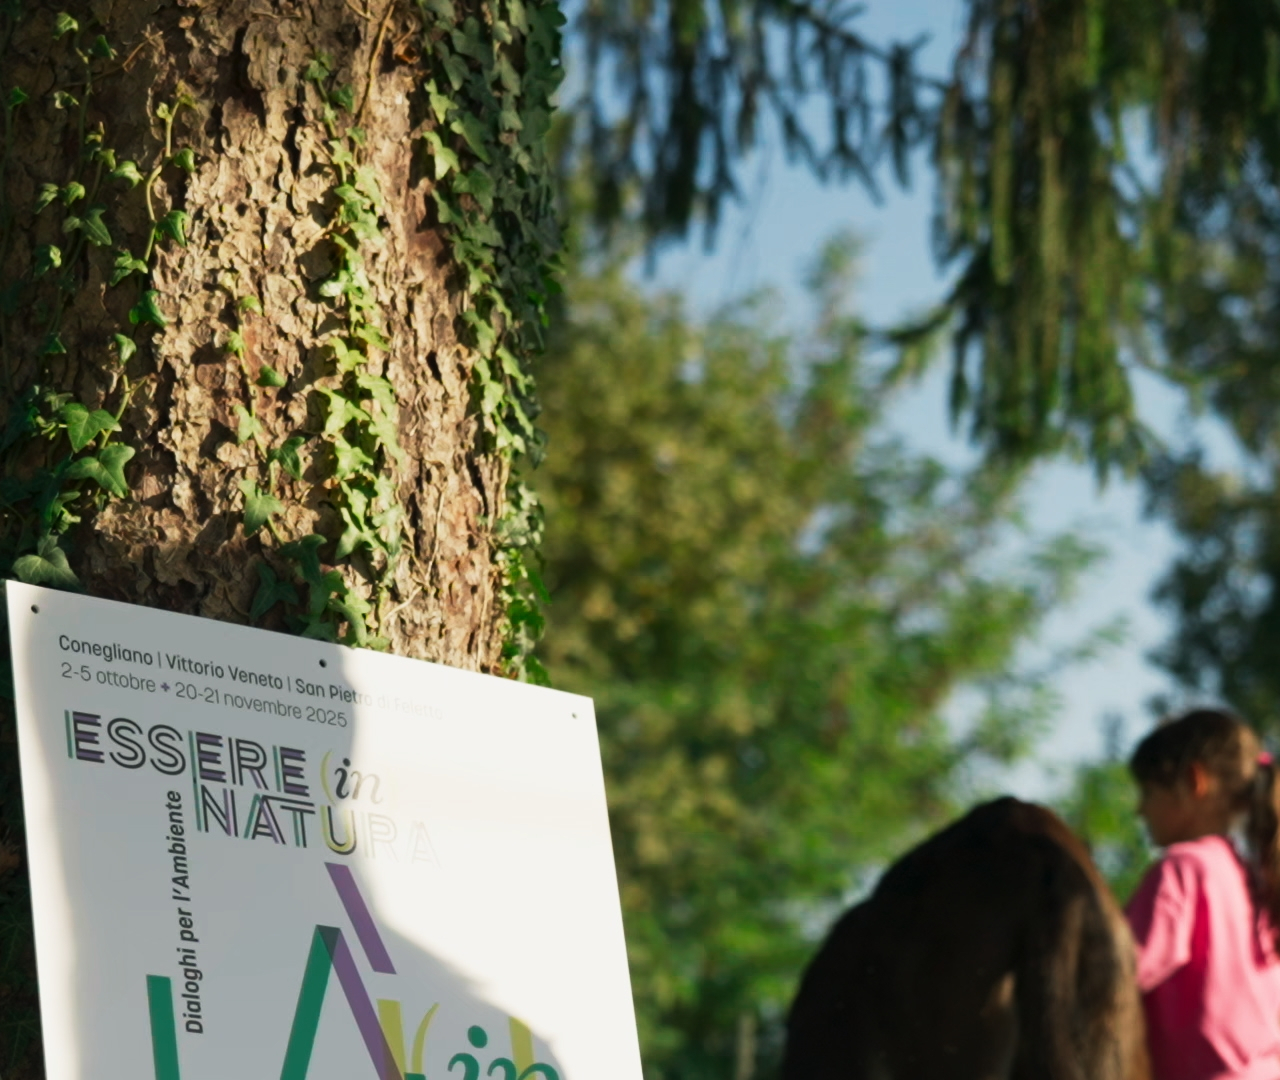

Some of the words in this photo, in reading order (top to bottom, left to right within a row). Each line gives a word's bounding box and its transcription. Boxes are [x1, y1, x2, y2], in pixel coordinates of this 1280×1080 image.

[59, 634, 153, 666] Conegliano
[165, 653, 225, 679] Vittorio
[228, 664, 283, 690] Veneto
[295, 678, 326, 699] San
[329, 684, 373, 706] Pietro
[61, 661, 92, 682] 2-5
[96, 670, 156, 693] ottobre
[175, 681, 220, 704] 20-21
[224, 692, 302, 719] novembre
[305, 705, 348, 728] 2025
[64, 709, 311, 798] ESSERE
[177, 907, 199, 943] per
[176, 948, 204, 1034] Dialoghi
